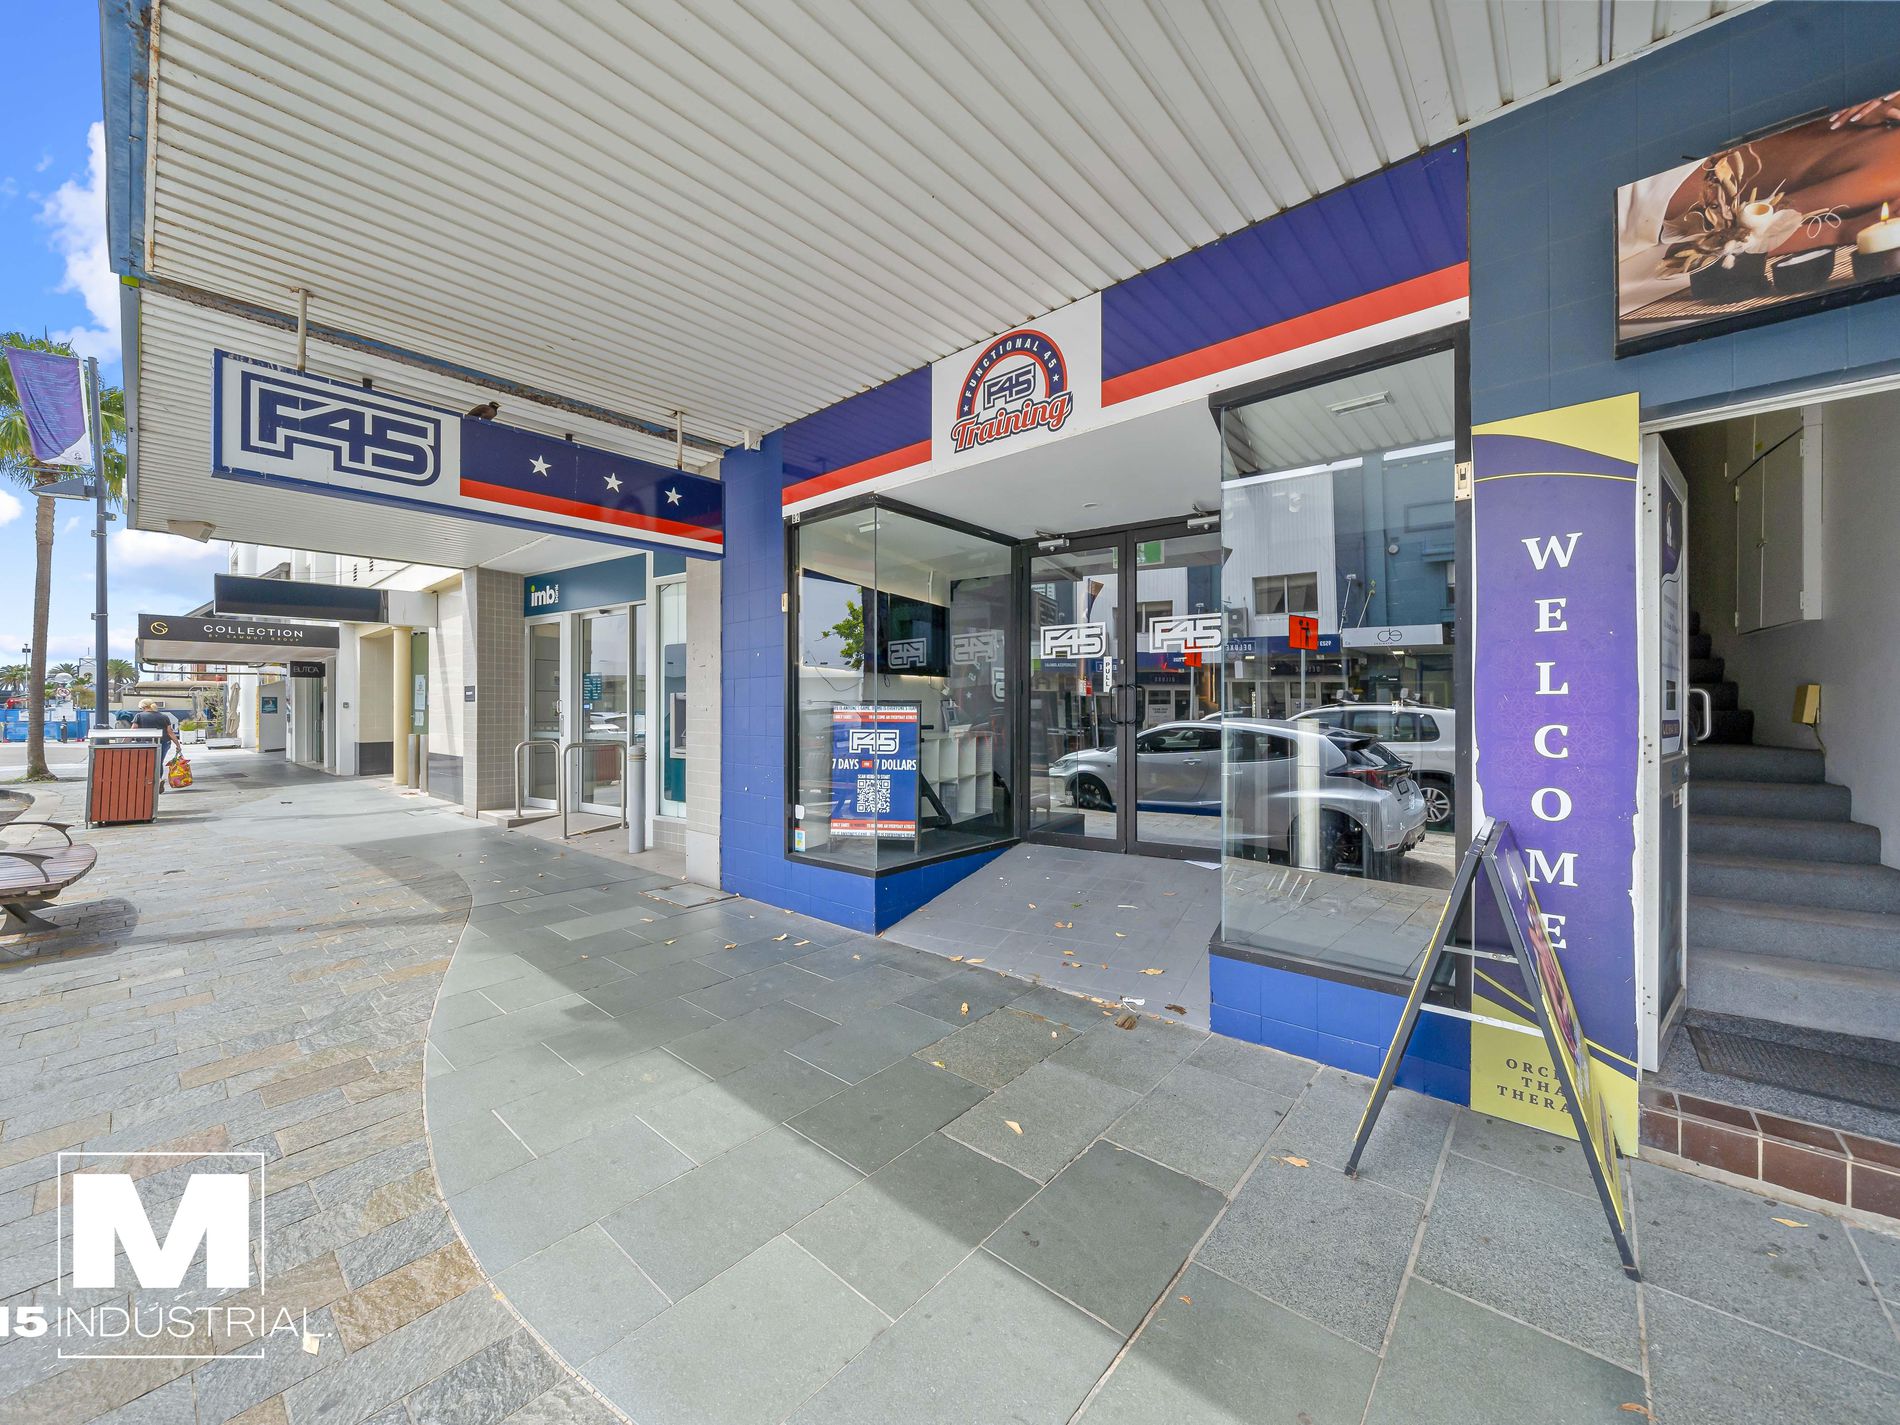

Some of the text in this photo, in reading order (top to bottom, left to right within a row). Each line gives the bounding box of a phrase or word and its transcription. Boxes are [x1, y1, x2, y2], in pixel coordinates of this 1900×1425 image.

[965, 338, 1057, 398] FUNCTIONAL 45
[984, 363, 1036, 410] F45
[245, 374, 439, 485] F45
[951, 394, 1071, 453] Training
[531, 584, 555, 607] imb
[203, 624, 303, 638] COLLECTION
[1040, 622, 1106, 659] F45
[1149, 612, 1221, 653] F45
[849, 729, 899, 754] F45
[1521, 532, 1583, 950] WELCOME
[838, 758, 859, 769] DAYS
[881, 759, 917, 771] DOLLARS
